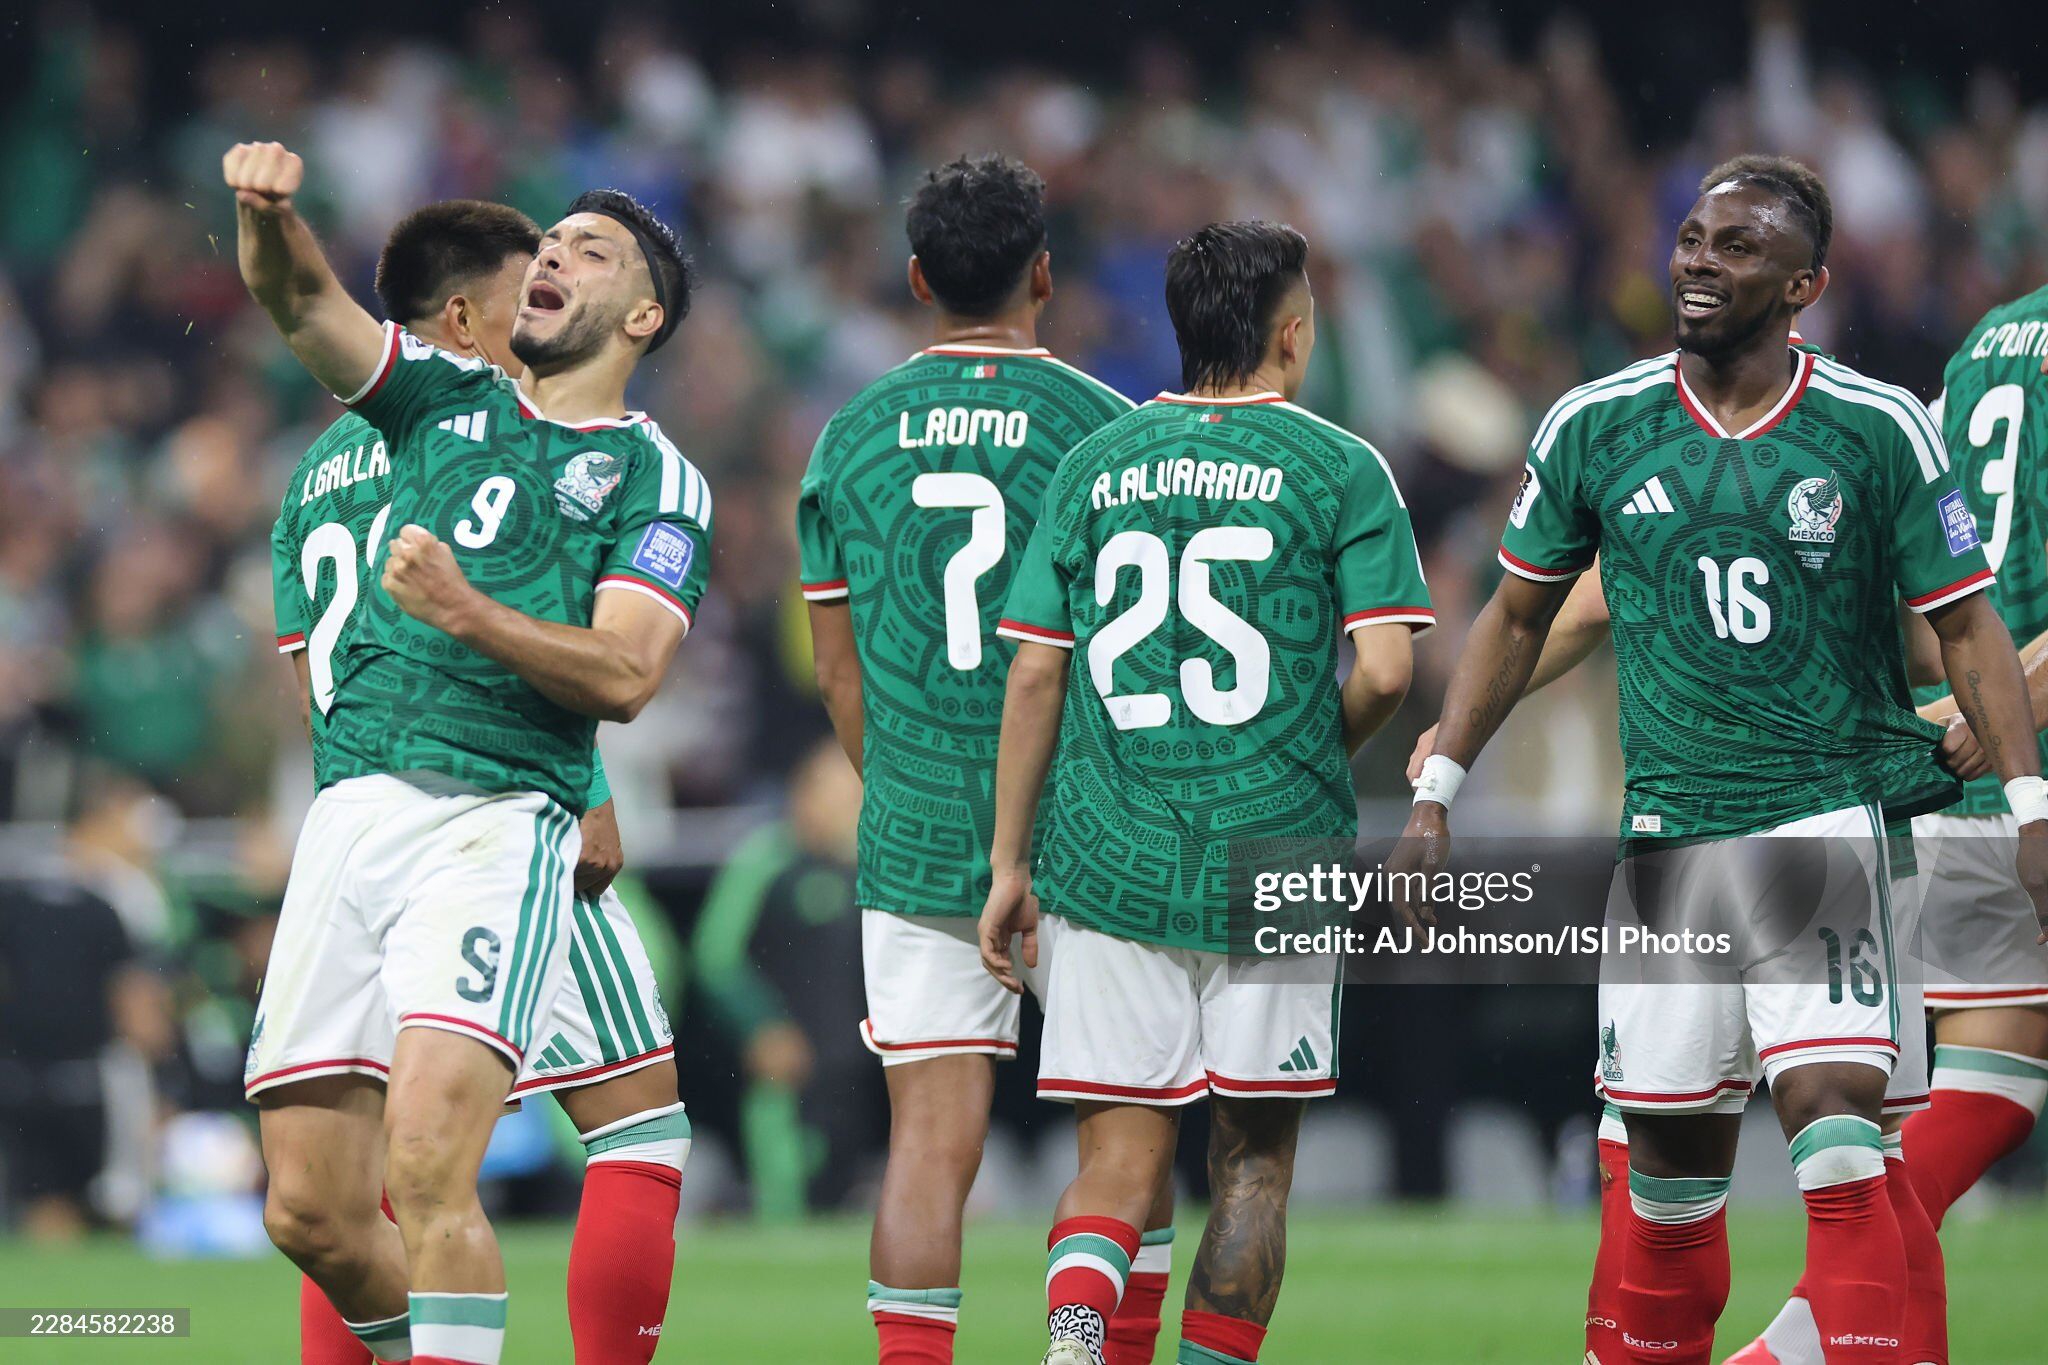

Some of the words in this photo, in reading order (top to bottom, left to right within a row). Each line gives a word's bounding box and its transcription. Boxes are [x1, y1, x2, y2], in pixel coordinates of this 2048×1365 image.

[898, 407, 1029, 449] L.ROMO
[300, 440, 391, 507] J.GALLA
[1091, 457, 1283, 510] R.ALVARADO
[1968, 383, 2024, 575] 3
[453, 475, 516, 549] 9
[1790, 528, 1835, 541] MÉXICO
[650, 537, 685, 564] UNITES
[911, 472, 1006, 671] 7
[1087, 526, 1274, 731] 25
[1697, 556, 1771, 644] 16
[456, 926, 501, 1004] 9
[1818, 926, 1884, 1008] 16
[1830, 1333, 1899, 1348] MÉXICO
